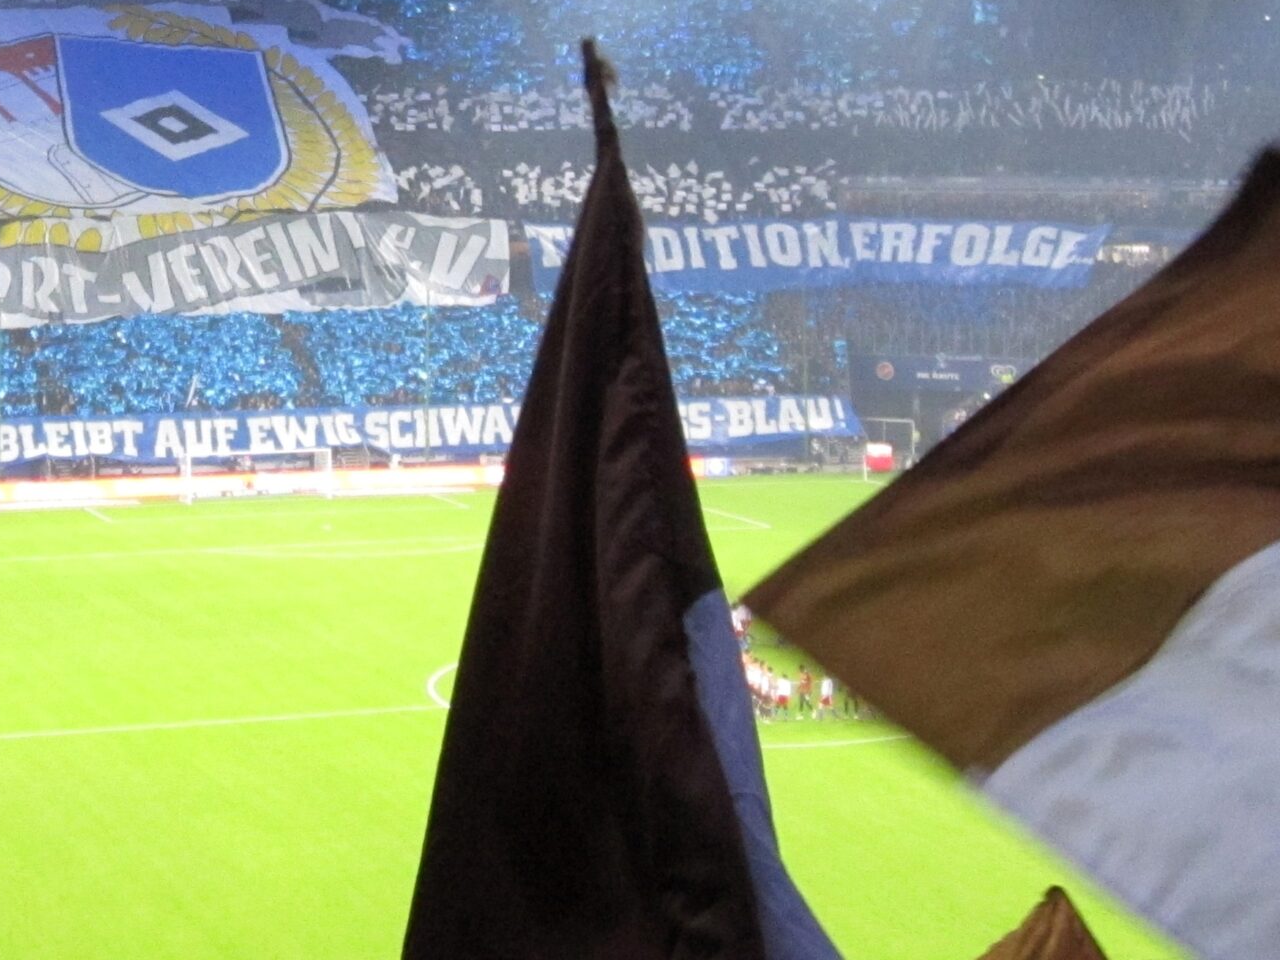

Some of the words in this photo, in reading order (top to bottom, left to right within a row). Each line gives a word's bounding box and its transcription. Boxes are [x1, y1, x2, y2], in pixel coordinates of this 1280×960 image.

[524, 222, 851, 273] TDITION,
[154, 417, 238, 458] AUF
[247, 413, 363, 451] EWIG
[364, 405, 521, 449] SCHWA
